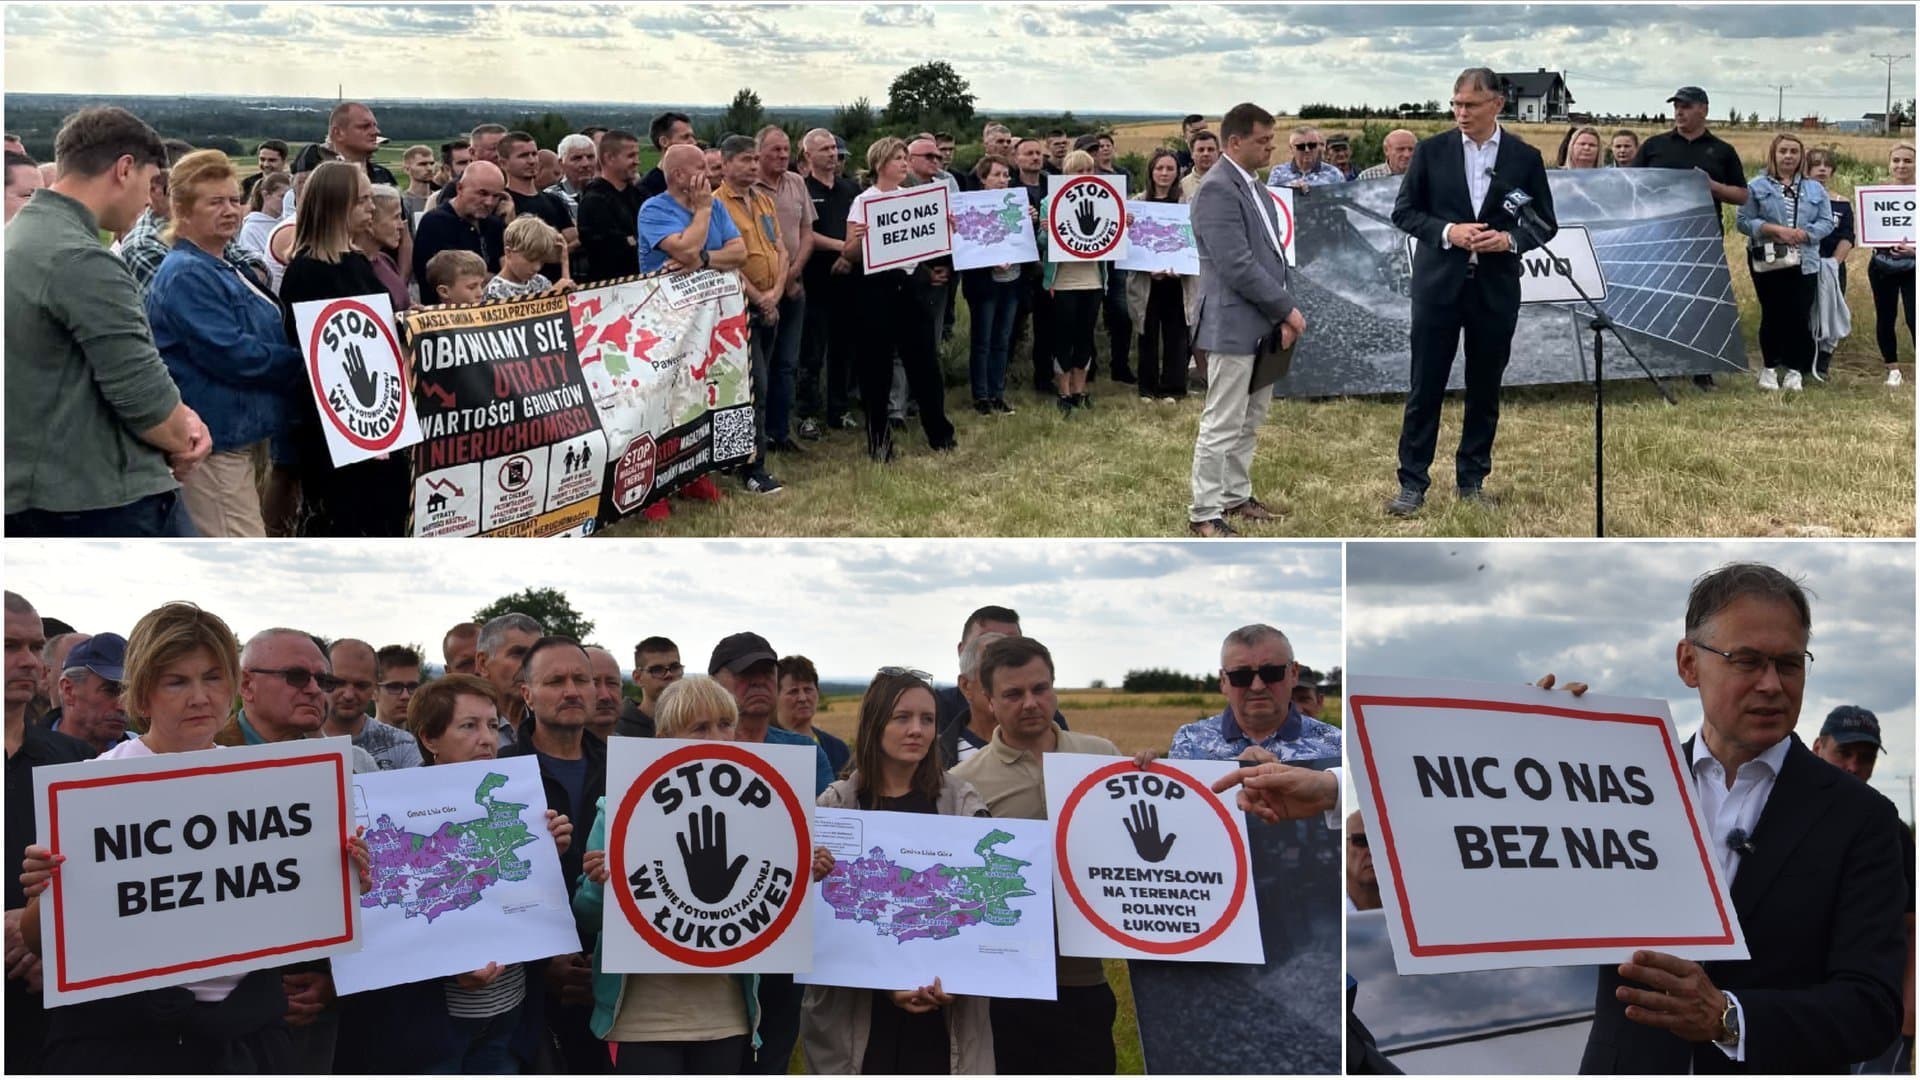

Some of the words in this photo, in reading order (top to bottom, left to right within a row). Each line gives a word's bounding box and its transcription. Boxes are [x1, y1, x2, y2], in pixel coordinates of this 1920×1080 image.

[1065, 184, 1109, 203] STOP
[1874, 201, 1899, 211] NIC
[1904, 201, 1916, 211] O
[877, 212, 898, 228] NIC
[901, 208, 912, 221] O
[914, 203, 939, 219] NAS
[1882, 217, 1912, 227] BEZ
[883, 229, 908, 246] BEZ
[911, 223, 936, 239] NAS
[1058, 222, 1069, 236] W
[1067, 221, 1118, 252] ŁUKOWEJ
[322, 311, 377, 352] STOP
[417, 316, 449, 329] NASZA
[480, 309, 508, 322] NASZA
[421, 326, 529, 373] OBAWIAMY
[533, 318, 568, 351] SIĘ
[493, 353, 569, 399] UTRATY
[329, 388, 345, 412] W
[349, 375, 401, 438] ŁUKOWEJ
[420, 399, 514, 440] WARTOŚCI
[523, 383, 584, 418] GRUNTÓW
[624, 442, 651, 467] STOP
[657, 436, 681, 461] STOP
[652, 763, 771, 815] STOP
[1105, 774, 1185, 800] STOP
[1413, 756, 1507, 799] NIC
[1514, 757, 1552, 801] O
[1558, 761, 1654, 805] NAS
[93, 819, 173, 863] NIC
[183, 814, 217, 850] O
[227, 803, 312, 845] NAS
[1454, 825, 1559, 869] BEZ
[1561, 827, 1658, 870] NAS
[117, 871, 205, 918] BEZ
[215, 858, 301, 902] NAS
[1088, 866, 1223, 885] PRZEMYSŁOWI
[653, 860, 678, 905] FARMIE
[677, 860, 771, 920] FOTOWOLTAICZNEJ
[1103, 886, 1125, 898] NA
[1130, 886, 1210, 901] TERENACH
[628, 864, 656, 900] W
[653, 867, 793, 948] ŁUKOWEJ
[1122, 903, 1196, 917] ROLNYCH
[1123, 919, 1200, 933] ŁUKOWEJ
